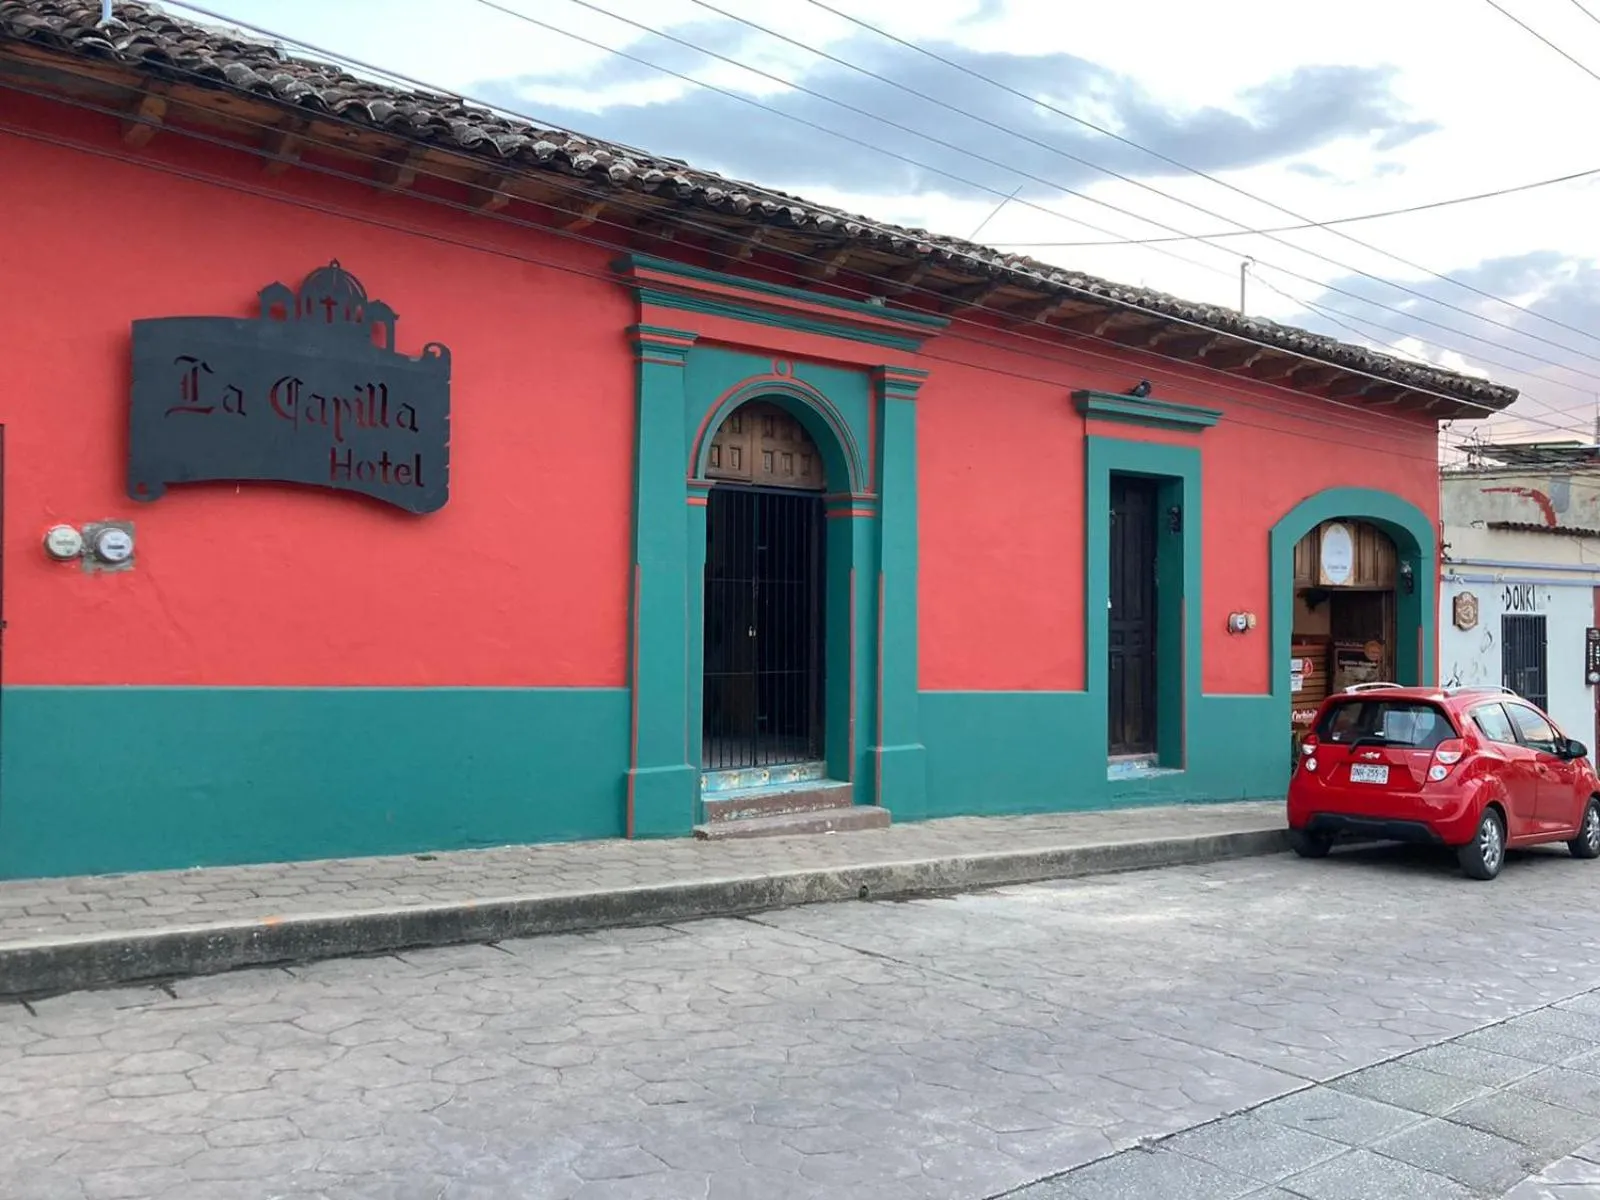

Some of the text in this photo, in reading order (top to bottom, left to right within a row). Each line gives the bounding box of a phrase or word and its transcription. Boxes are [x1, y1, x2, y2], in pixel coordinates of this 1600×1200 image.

[164, 355, 419, 443] La Capilla
[329, 446, 425, 488] Hotel
